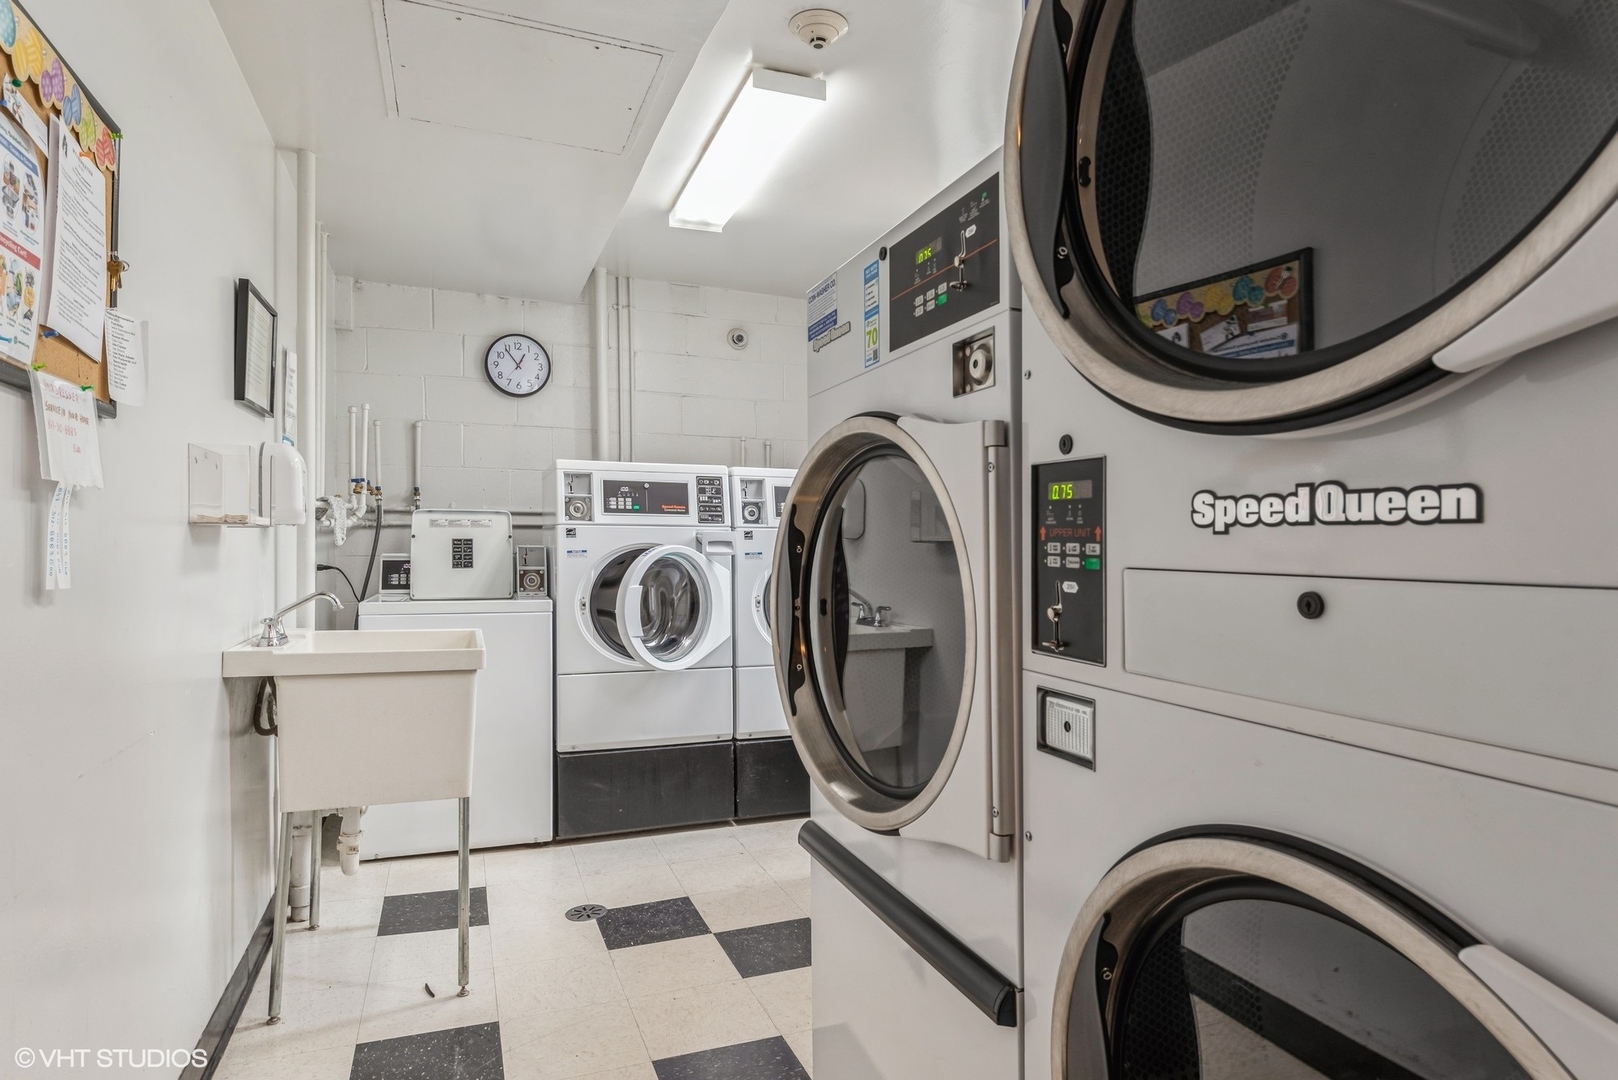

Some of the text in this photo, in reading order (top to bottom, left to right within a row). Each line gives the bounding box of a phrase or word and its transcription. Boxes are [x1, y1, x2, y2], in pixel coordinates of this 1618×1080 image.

[866, 327, 878, 349] 70
[504, 344, 511, 352] 11
[513, 342, 522, 351] 12
[527, 345, 531, 353] 1
[496, 351, 505, 360] 10
[533, 352, 540, 361] 2
[493, 360, 500, 369] 9
[538, 363, 544, 371] 3
[497, 371, 503, 380] 8
[506, 378, 512, 386] 7
[527, 379, 533, 388] 5
[1052, 484, 1073, 500] 0.75
[1191, 480, 1484, 535] Speed Queen
[1049, 528, 1092, 538] UPPER UNIT
